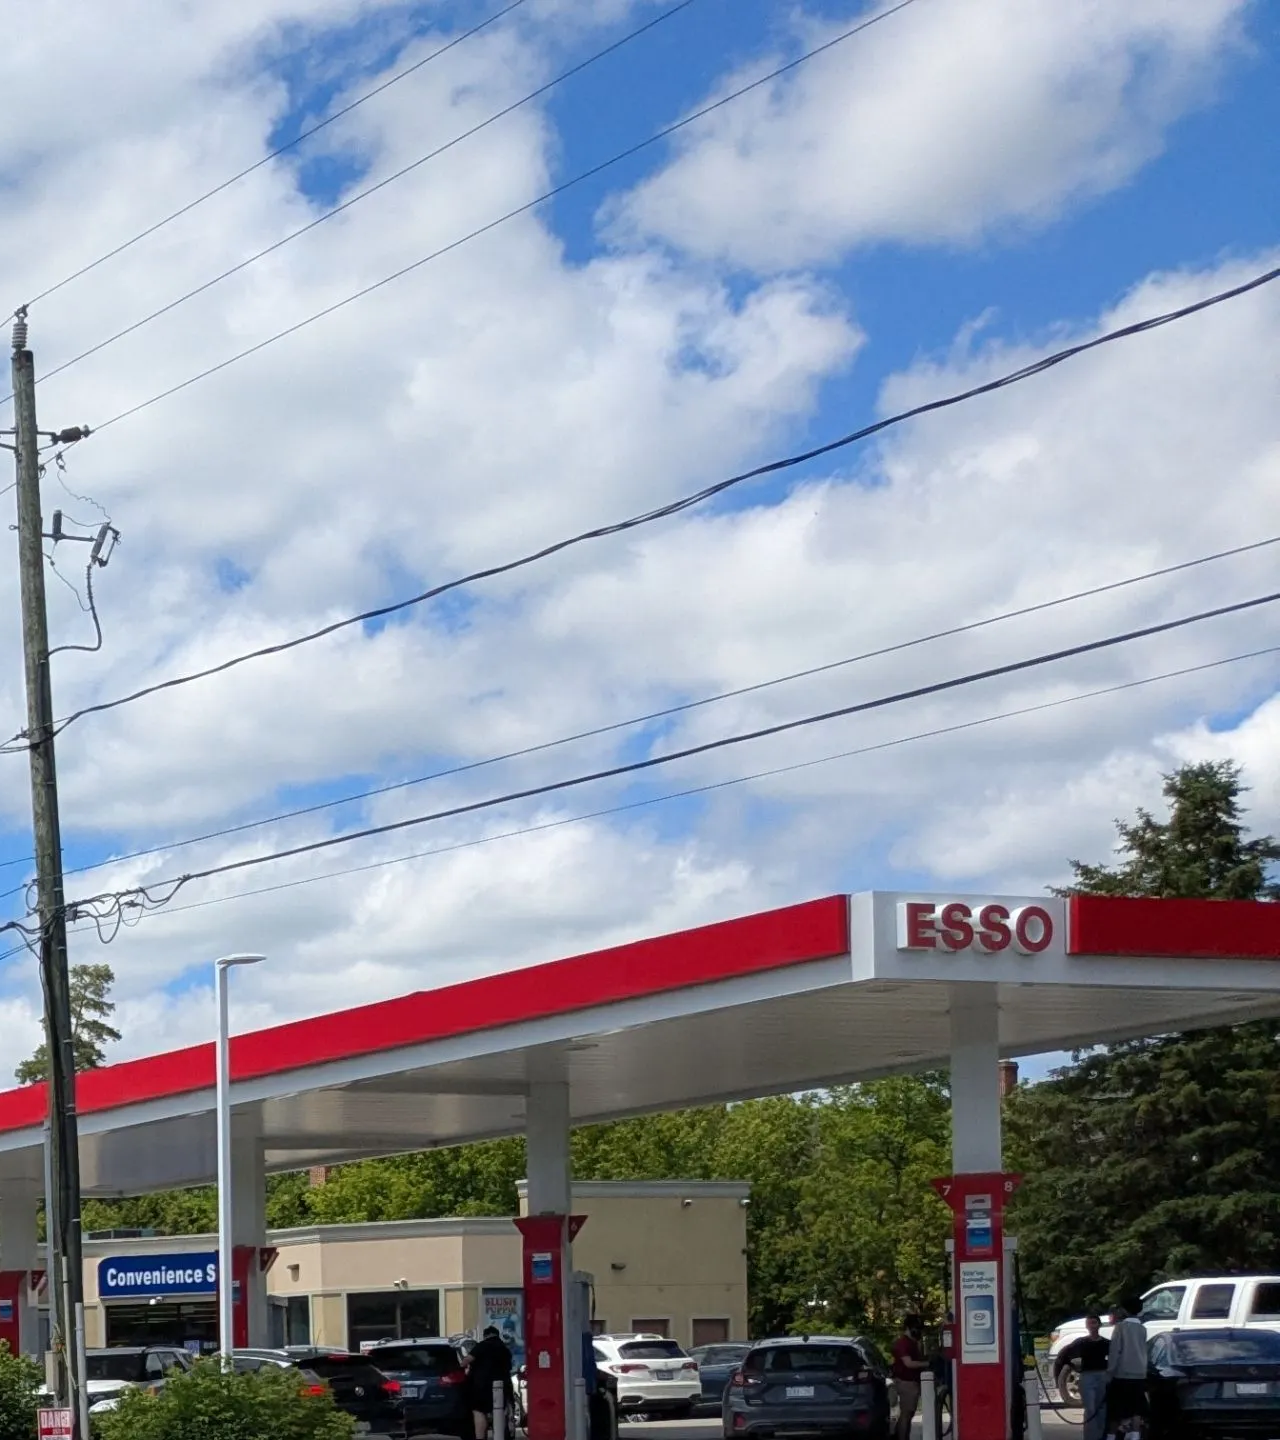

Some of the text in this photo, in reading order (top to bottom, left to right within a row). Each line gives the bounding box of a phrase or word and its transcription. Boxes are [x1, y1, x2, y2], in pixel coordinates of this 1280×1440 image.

[906, 902, 1053, 953] ESSO
[942, 1185, 951, 1196] 7
[1004, 1181, 1013, 1192] 8
[107, 1263, 217, 1287] Convenience S
